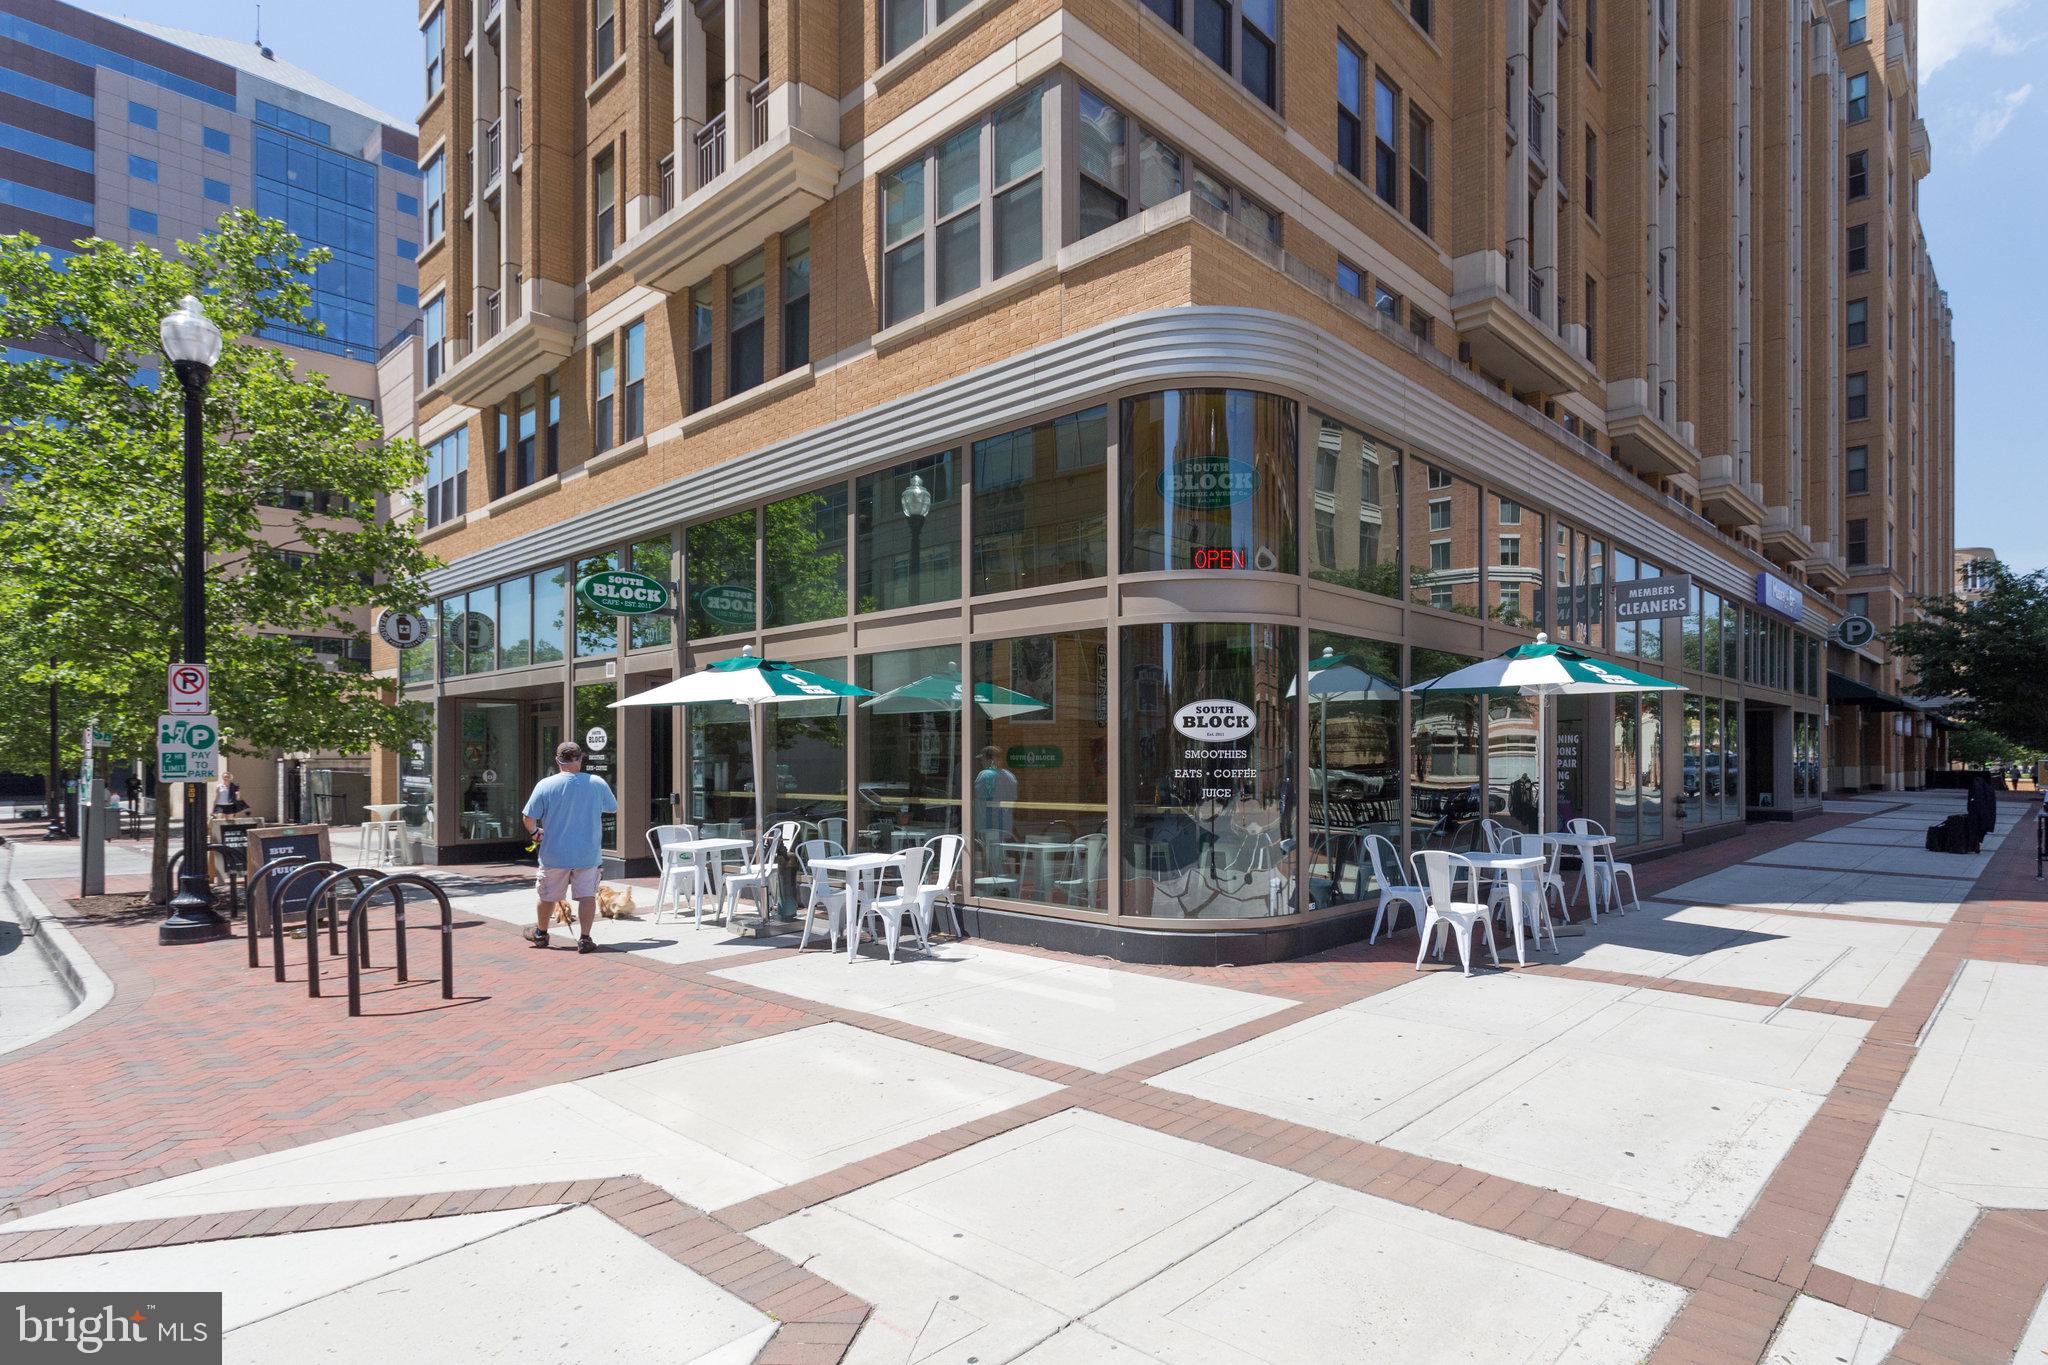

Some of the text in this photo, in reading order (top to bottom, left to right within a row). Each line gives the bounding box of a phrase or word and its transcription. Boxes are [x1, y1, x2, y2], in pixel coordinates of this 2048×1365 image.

[1185, 463, 1228, 472] SOUTH
[1167, 473, 1252, 490] BLOCK
[1194, 549, 1245, 569] OPEN
[608, 576, 644, 587] SOUTH
[592, 583, 661, 603] BLOCK
[1629, 585, 1675, 598] MEMBERS
[1618, 597, 1687, 616] CLEANERS
[1846, 621, 1867, 642] P
[1196, 706, 1234, 714] SOUTH
[1182, 715, 1250, 729] BLOCK
[1557, 734, 1579, 744] NING
[191, 751, 211, 759] PAY
[1184, 749, 1247, 759] SMOOTHIES
[1556, 746, 1577, 756] IONS
[165, 753, 172, 763] 2
[1557, 758, 1577, 768] PAIR
[195, 761, 208, 769] TO
[188, 770, 214, 778] PARK
[1174, 769, 1257, 778] EATS COFFEE
[1202, 788, 1232, 799] JUICE
[269, 846, 294, 855] BUT
[271, 864, 302, 876] JUIC
